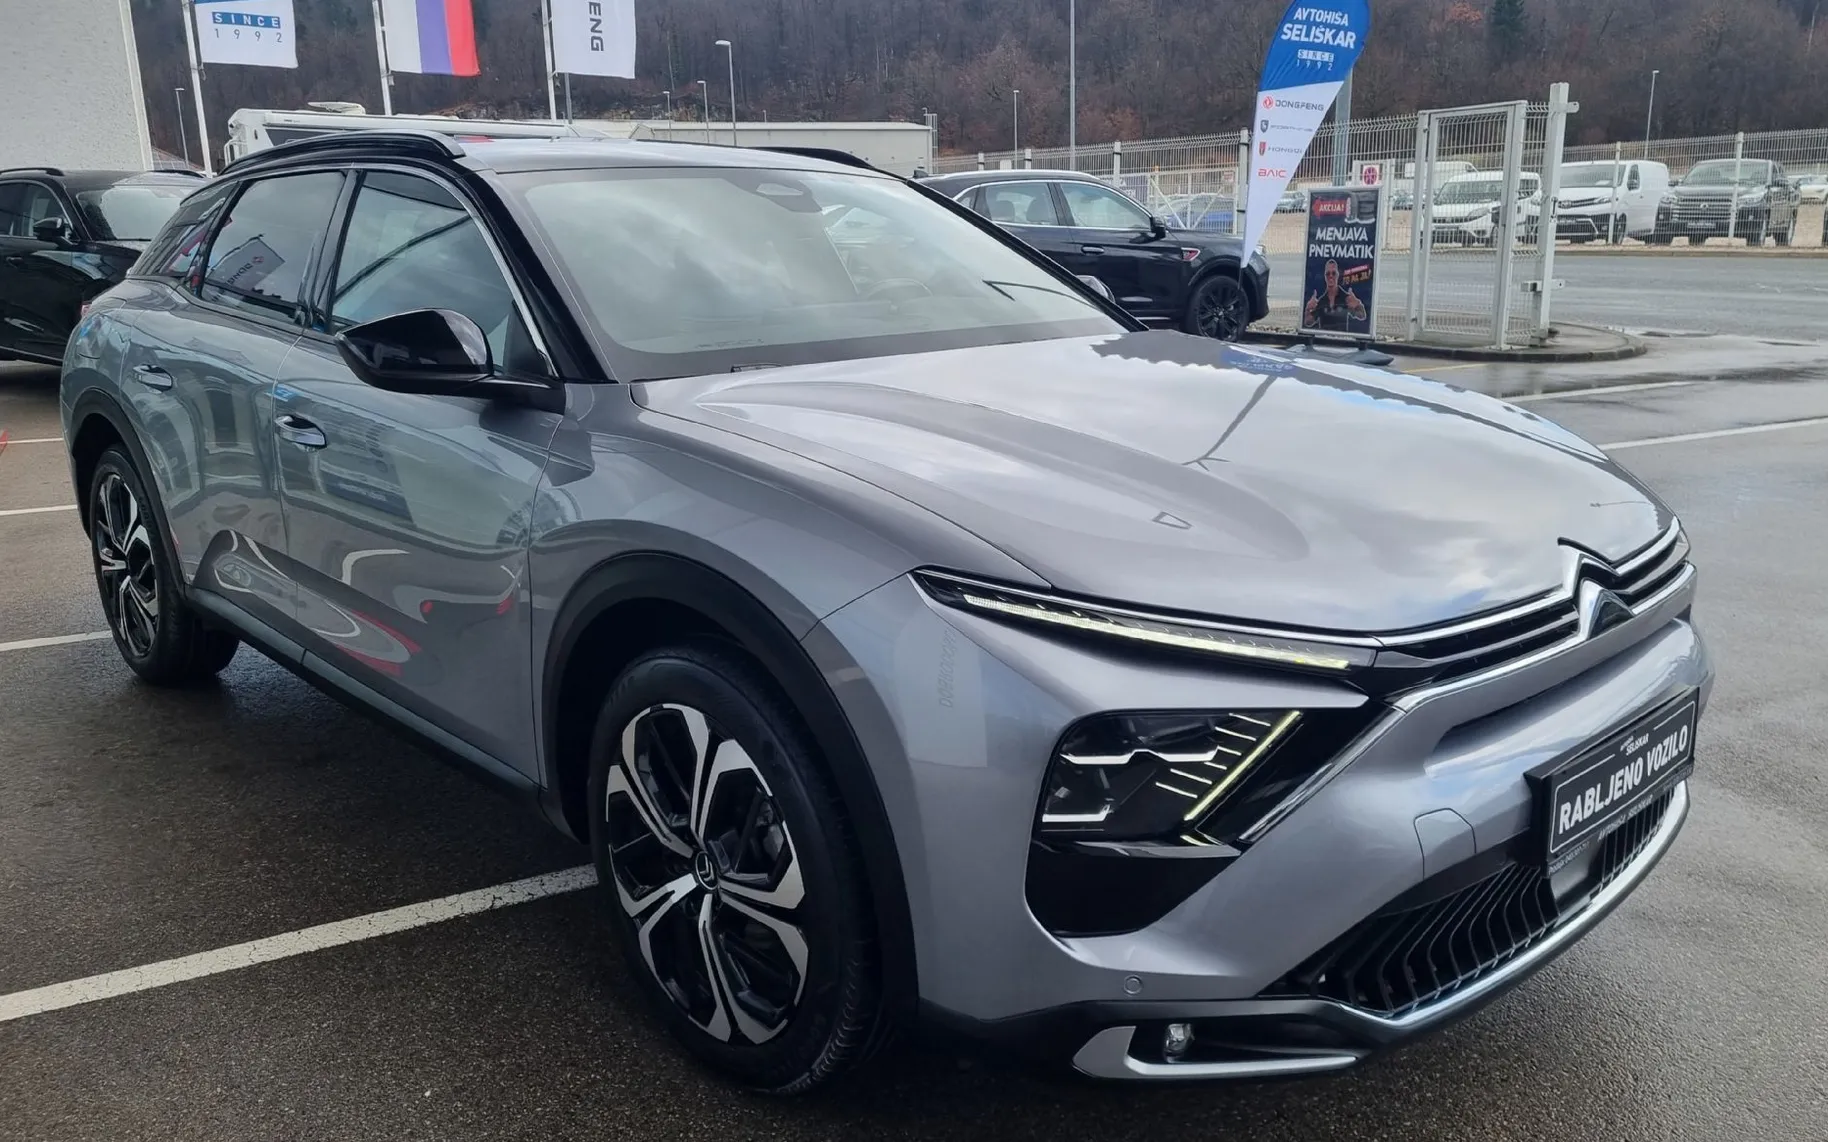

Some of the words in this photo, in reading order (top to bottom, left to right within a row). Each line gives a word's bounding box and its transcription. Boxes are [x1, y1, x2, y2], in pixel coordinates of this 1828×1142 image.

[213, 12, 280, 28] SINCE
[588, 1, 604, 52] ENG
[214, 28, 283, 43] 1992
[1280, 23, 1356, 49] SELIŠKAR
[1299, 50, 1334, 62] SINCE
[1296, 59, 1333, 71] 1992
[1275, 99, 1324, 111] DONGFENG
[1258, 168, 1287, 178] BAIC
[1318, 203, 1345, 212] AKCIJA!
[1315, 226, 1368, 241] MENJAVA
[1308, 244, 1374, 259] PNEVMATIK
[1558, 757, 1643, 835] RABLJENO
[1646, 724, 1688, 776] VOZILO
